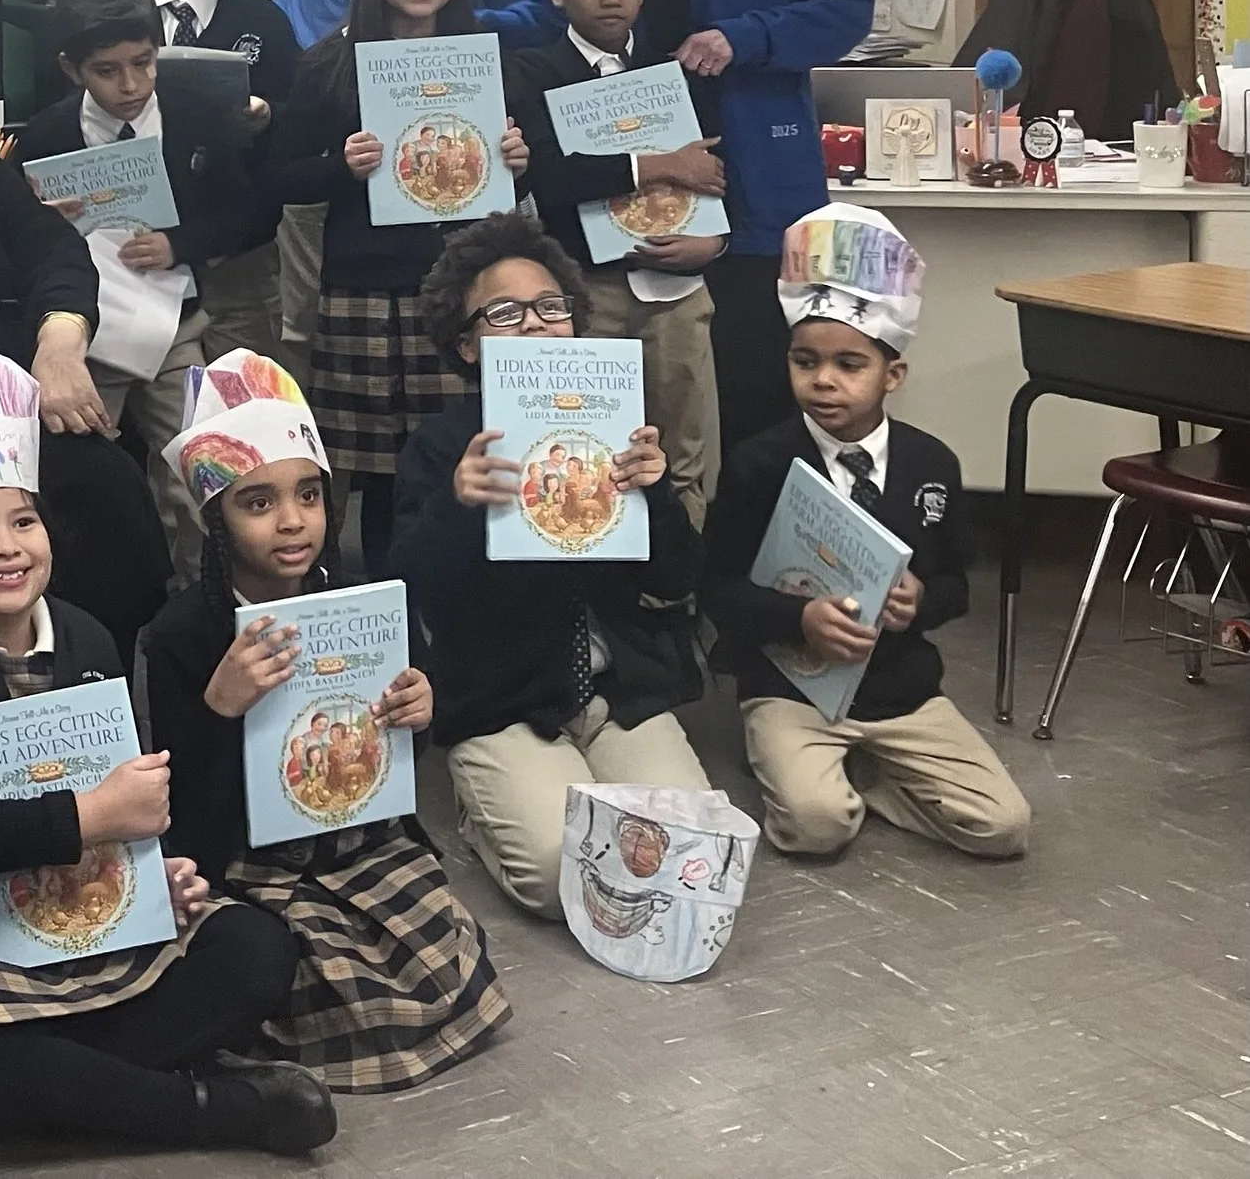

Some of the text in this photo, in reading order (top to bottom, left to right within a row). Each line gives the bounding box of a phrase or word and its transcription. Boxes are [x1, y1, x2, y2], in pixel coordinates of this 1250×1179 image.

[368, 51, 496, 72] LIDIA'S EGG-CITING
[372, 65, 495, 85] FARM ADVENTURE
[559, 98, 601, 117] LIDIA'S
[603, 79, 682, 107] EGG-CITING
[565, 92, 683, 128] FARM ADVENTURE
[43, 172, 78, 188] IDIA'S
[46, 186, 77, 200] ARM
[496, 359, 638, 375] LIDIA'S EGG-CITING
[500, 375, 635, 391] FARM ADVENTURE
[525, 411, 612, 421] LIDIA BASTIANICH
[308, 610, 402, 638] EGG-CITING
[305, 627, 399, 657] ADVENTURE
[15, 707, 124, 742] EGG-CITING
[15, 727, 126, 763] ADVENTURE
